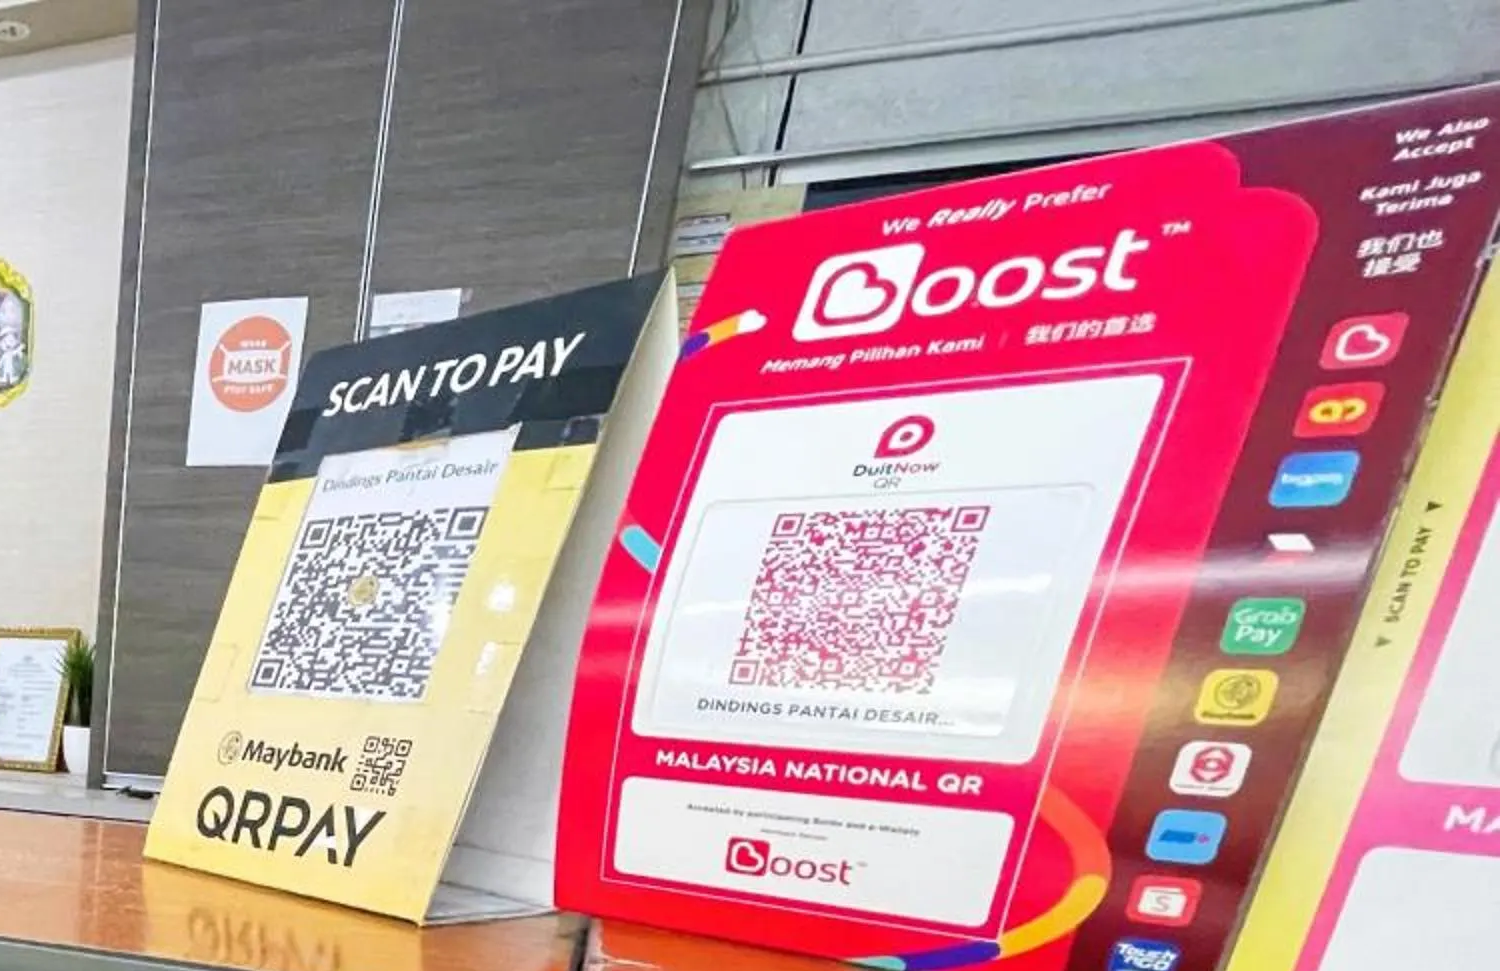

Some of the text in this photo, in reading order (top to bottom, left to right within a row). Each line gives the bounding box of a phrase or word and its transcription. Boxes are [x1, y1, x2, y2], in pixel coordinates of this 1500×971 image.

[1396, 117, 1490, 145] We Also
[1392, 136, 1476, 162] Accept
[1359, 171, 1483, 201] Kami Juga
[882, 182, 1113, 236] We Really Prefer
[1375, 193, 1455, 216] Terima
[227, 358, 276, 375] MASK
[760, 334, 985, 375] Memang Pilihan Kami
[321, 332, 586, 418] SCAN TO PAY
[385, 465, 439, 484] Pantai
[442, 458, 499, 479] Desair
[852, 461, 941, 477] DuitNow
[1384, 526, 1433, 623] SCAN TO PAY
[1234, 606, 1298, 626] Grab
[1234, 624, 1282, 646] Pay
[697, 697, 783, 717] DINDINGS
[787, 703, 858, 722] PANTAI
[241, 740, 349, 775] Maybank
[655, 749, 984, 797] MALAYSIA NATIONAL QR
[197, 785, 387, 868] QRPAY
